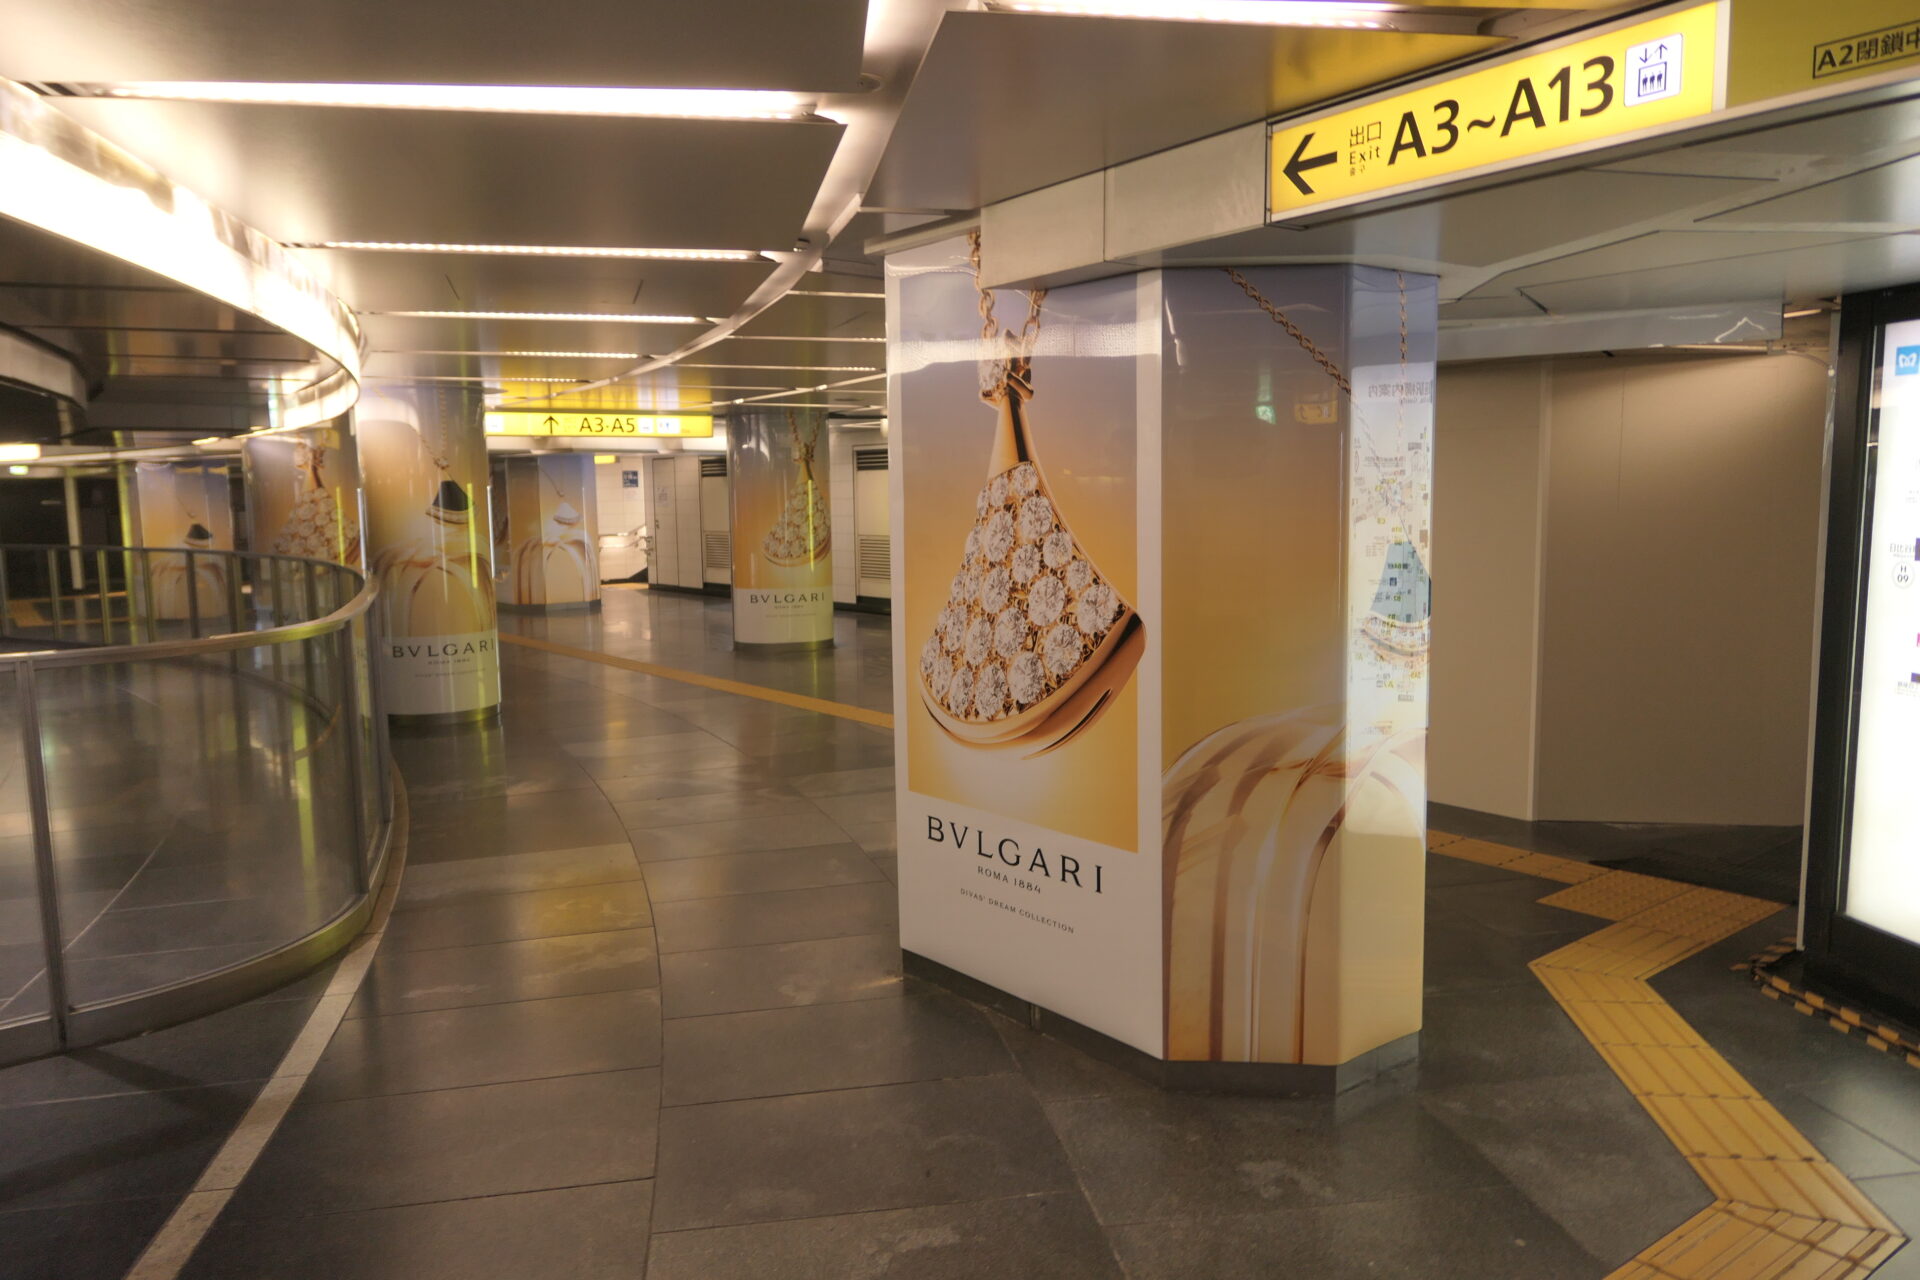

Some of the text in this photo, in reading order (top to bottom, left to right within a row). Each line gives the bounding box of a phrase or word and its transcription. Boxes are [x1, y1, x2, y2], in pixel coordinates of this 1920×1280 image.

[1349, 121, 1382, 148] 出口
[1349, 146, 1380, 165] Exit
[750, 592, 825, 604] BVLGARI
[391, 639, 494, 658] BVLGARI
[927, 815, 1103, 894] BVLGARI
[977, 866, 1041, 894] ROMA 1884
[988, 898, 1016, 913] DREAM
[1019, 909, 1074, 934] COLLECTION
